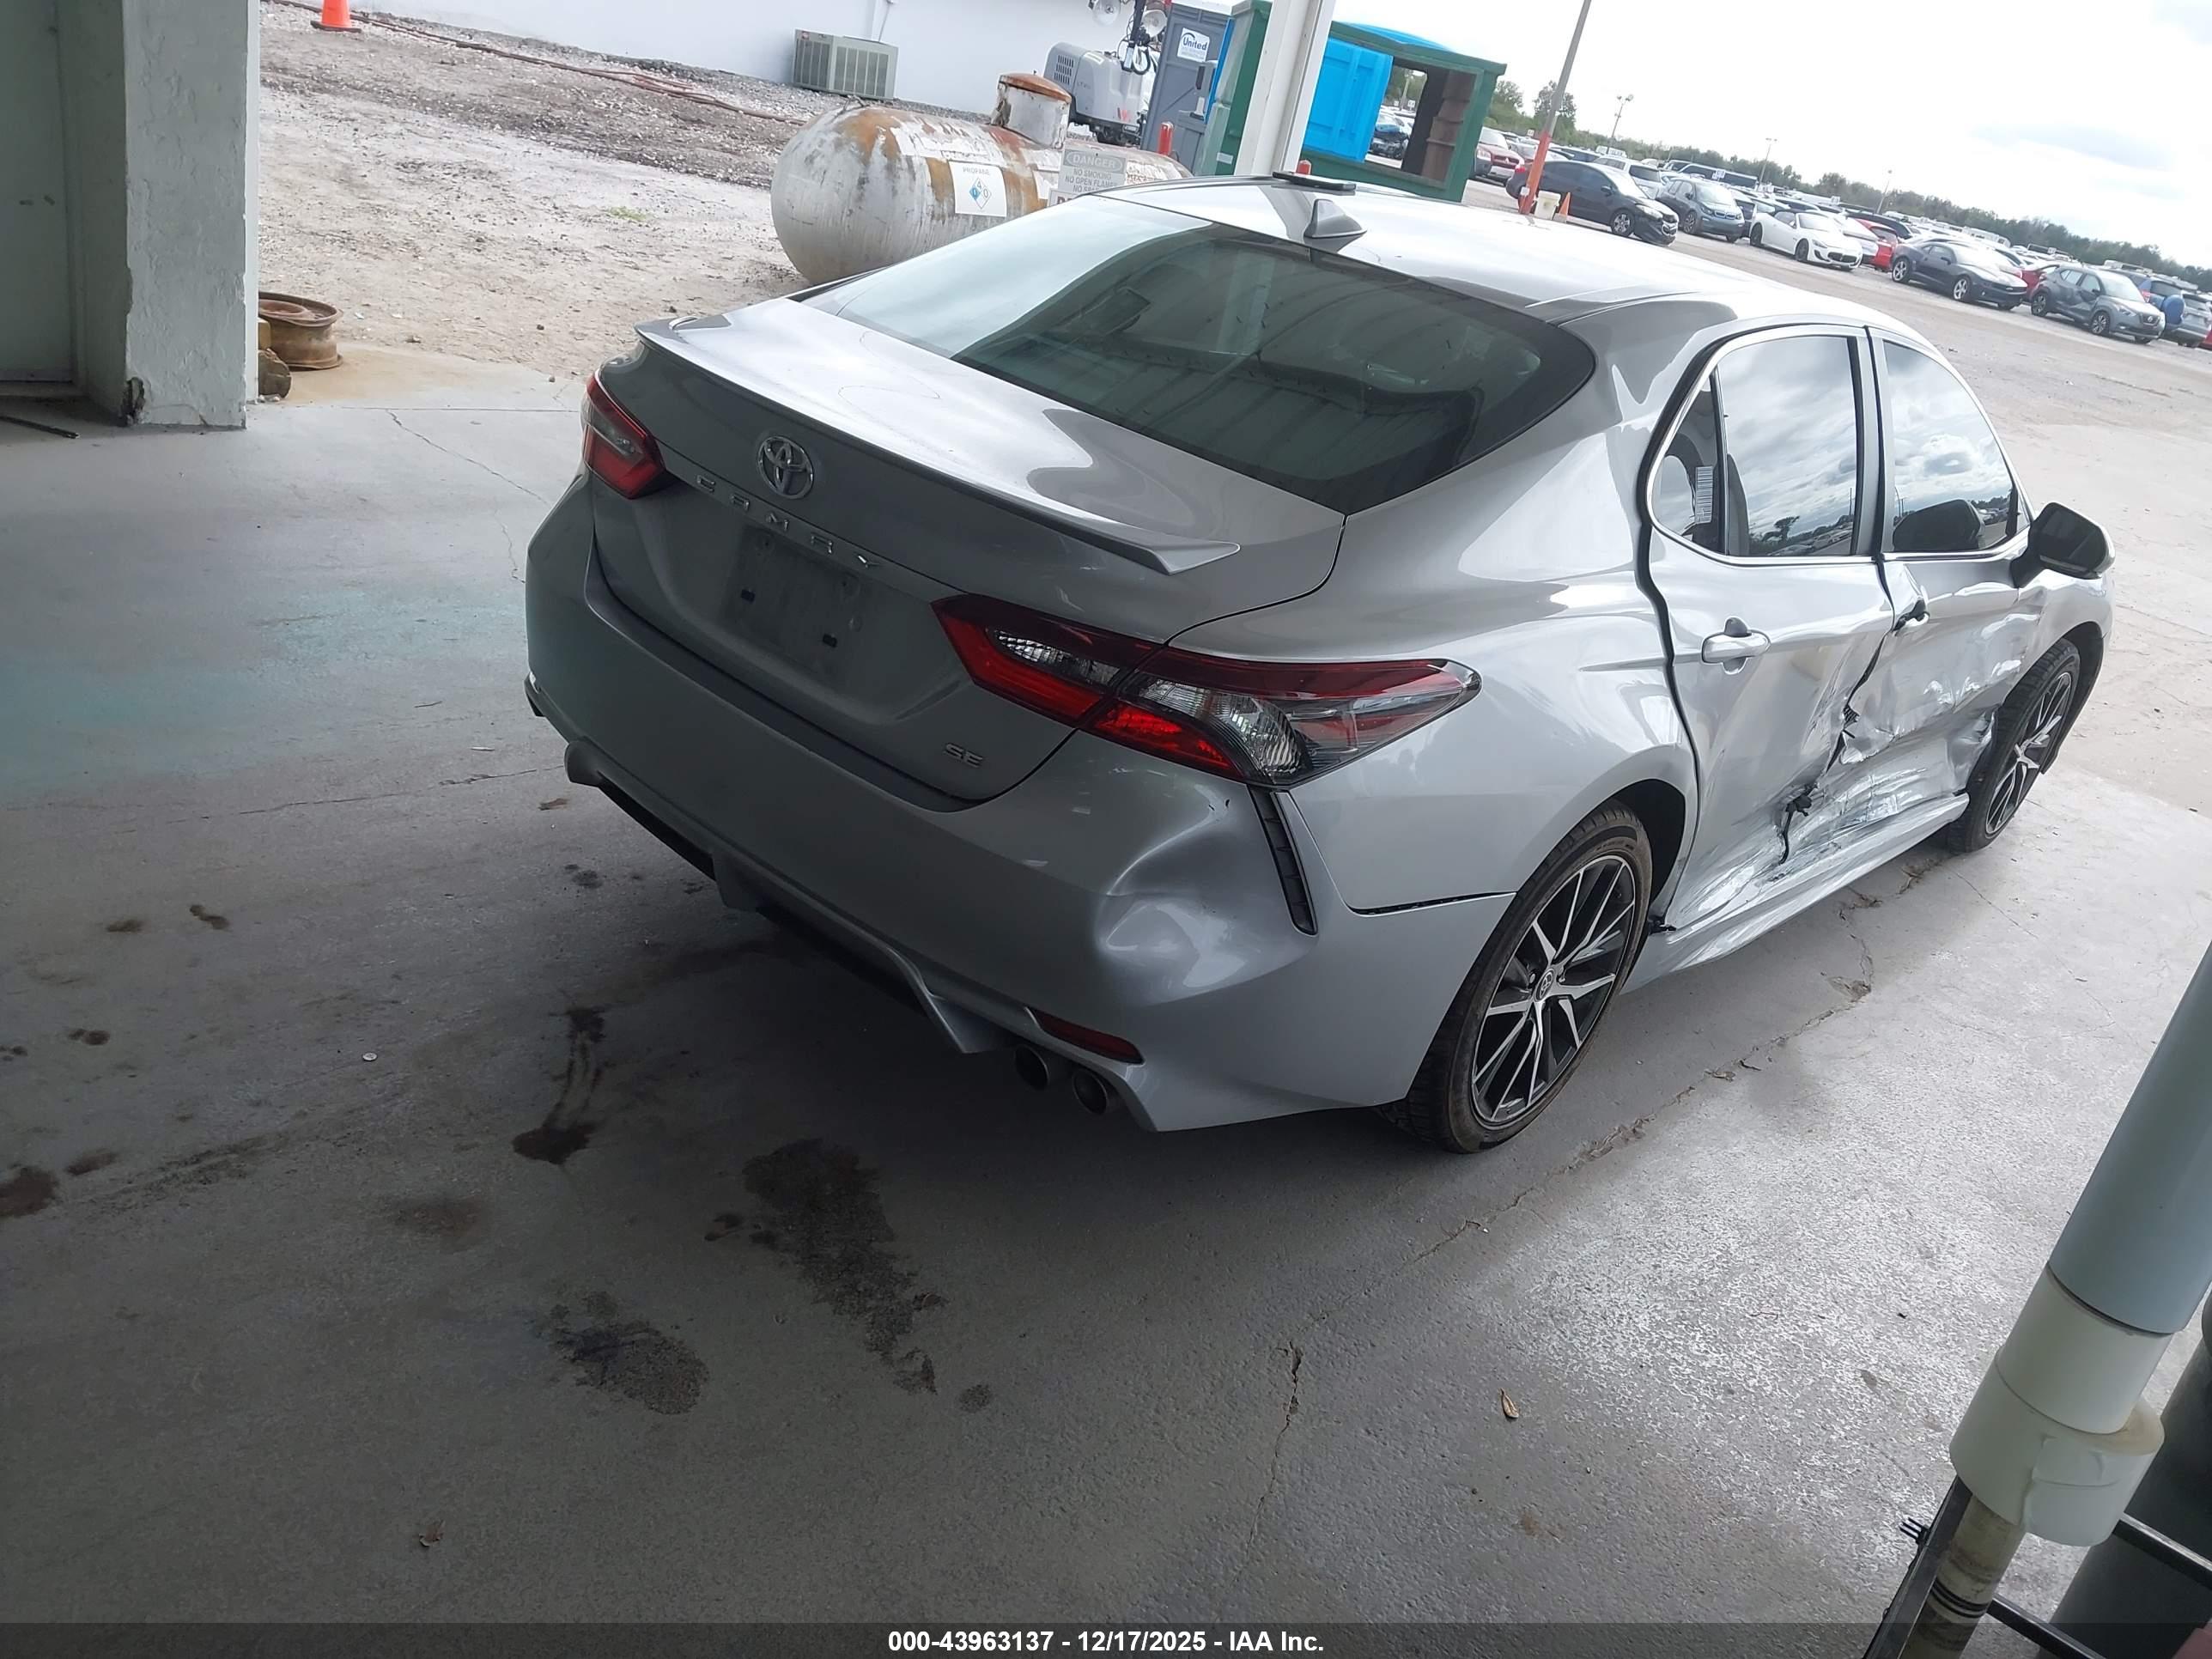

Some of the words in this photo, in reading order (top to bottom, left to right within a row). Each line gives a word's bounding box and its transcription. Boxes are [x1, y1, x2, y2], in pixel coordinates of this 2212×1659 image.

[1182, 37, 1207, 51] United
[1073, 154, 1115, 169] DANGER
[1084, 169, 1112, 179] SMOKING
[1075, 177, 1092, 186] OPEN
[696, 475, 880, 568] CAMRY
[944, 742, 984, 768] SE
